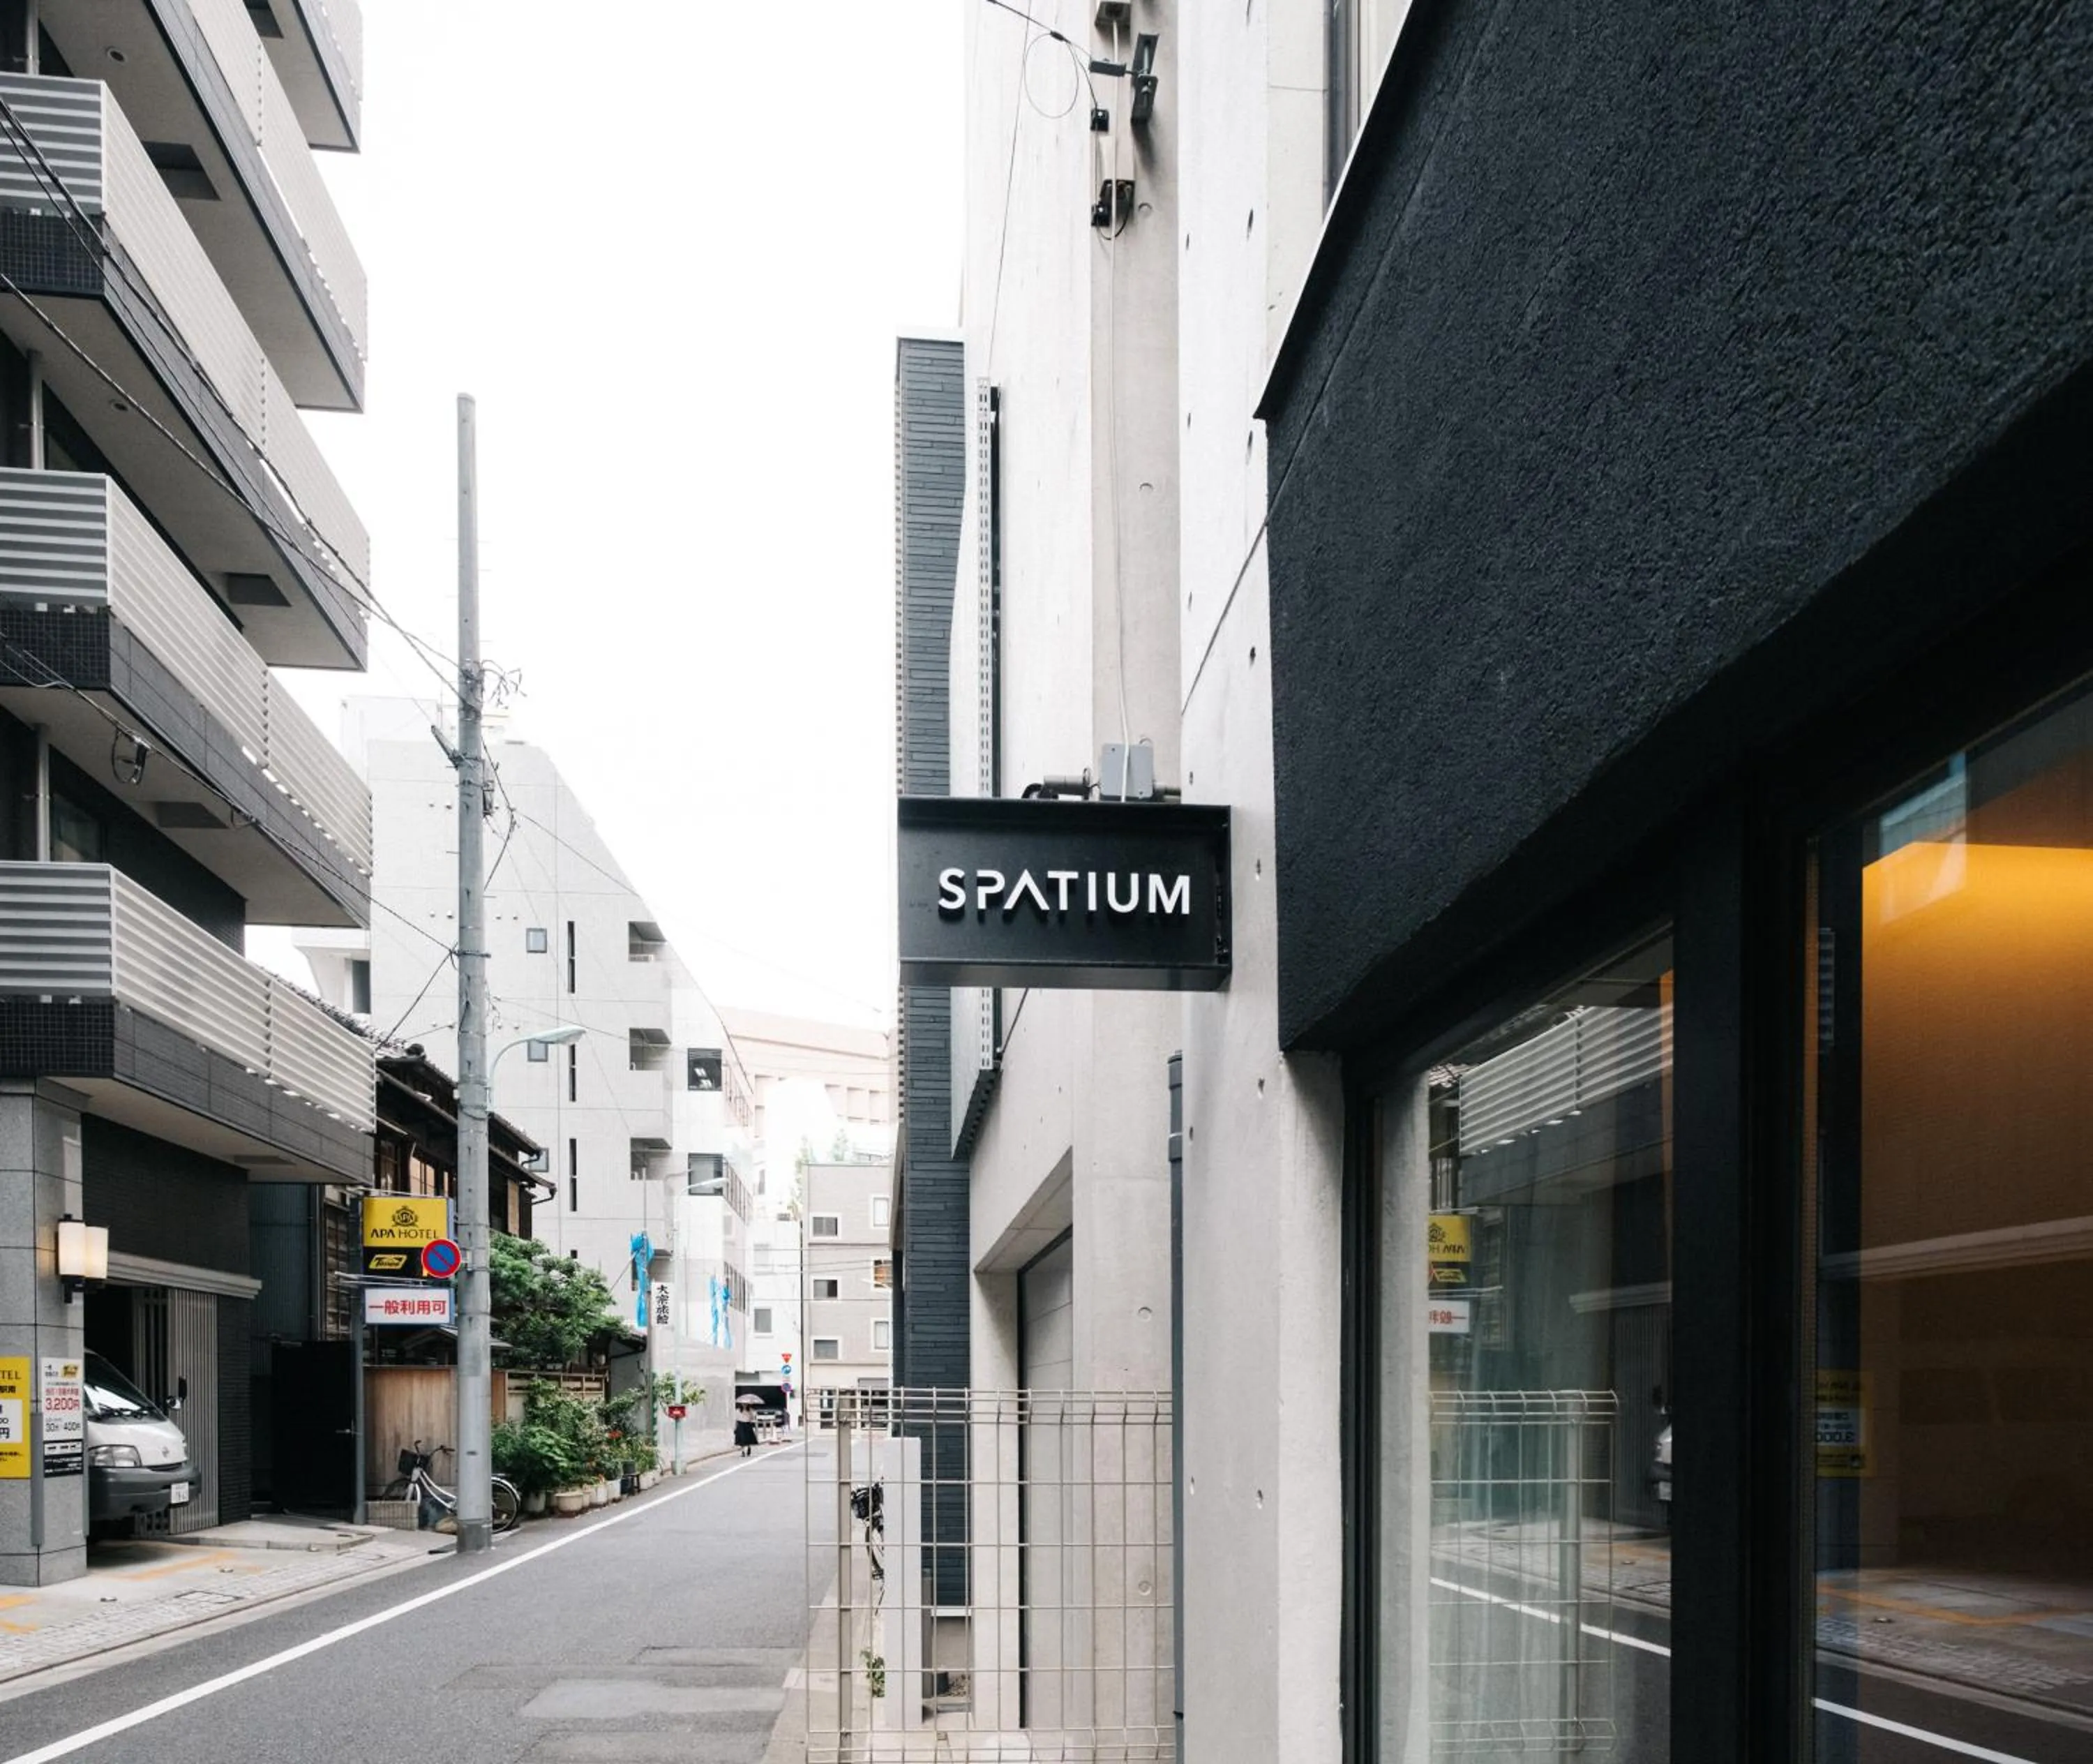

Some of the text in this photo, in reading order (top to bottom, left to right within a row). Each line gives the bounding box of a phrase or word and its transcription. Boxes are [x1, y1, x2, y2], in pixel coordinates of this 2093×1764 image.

[938, 867, 1190, 915] SPATIUM
[370, 1228, 438, 1239] APA HOTEL
[368, 1300, 447, 1315] 一般利用可
